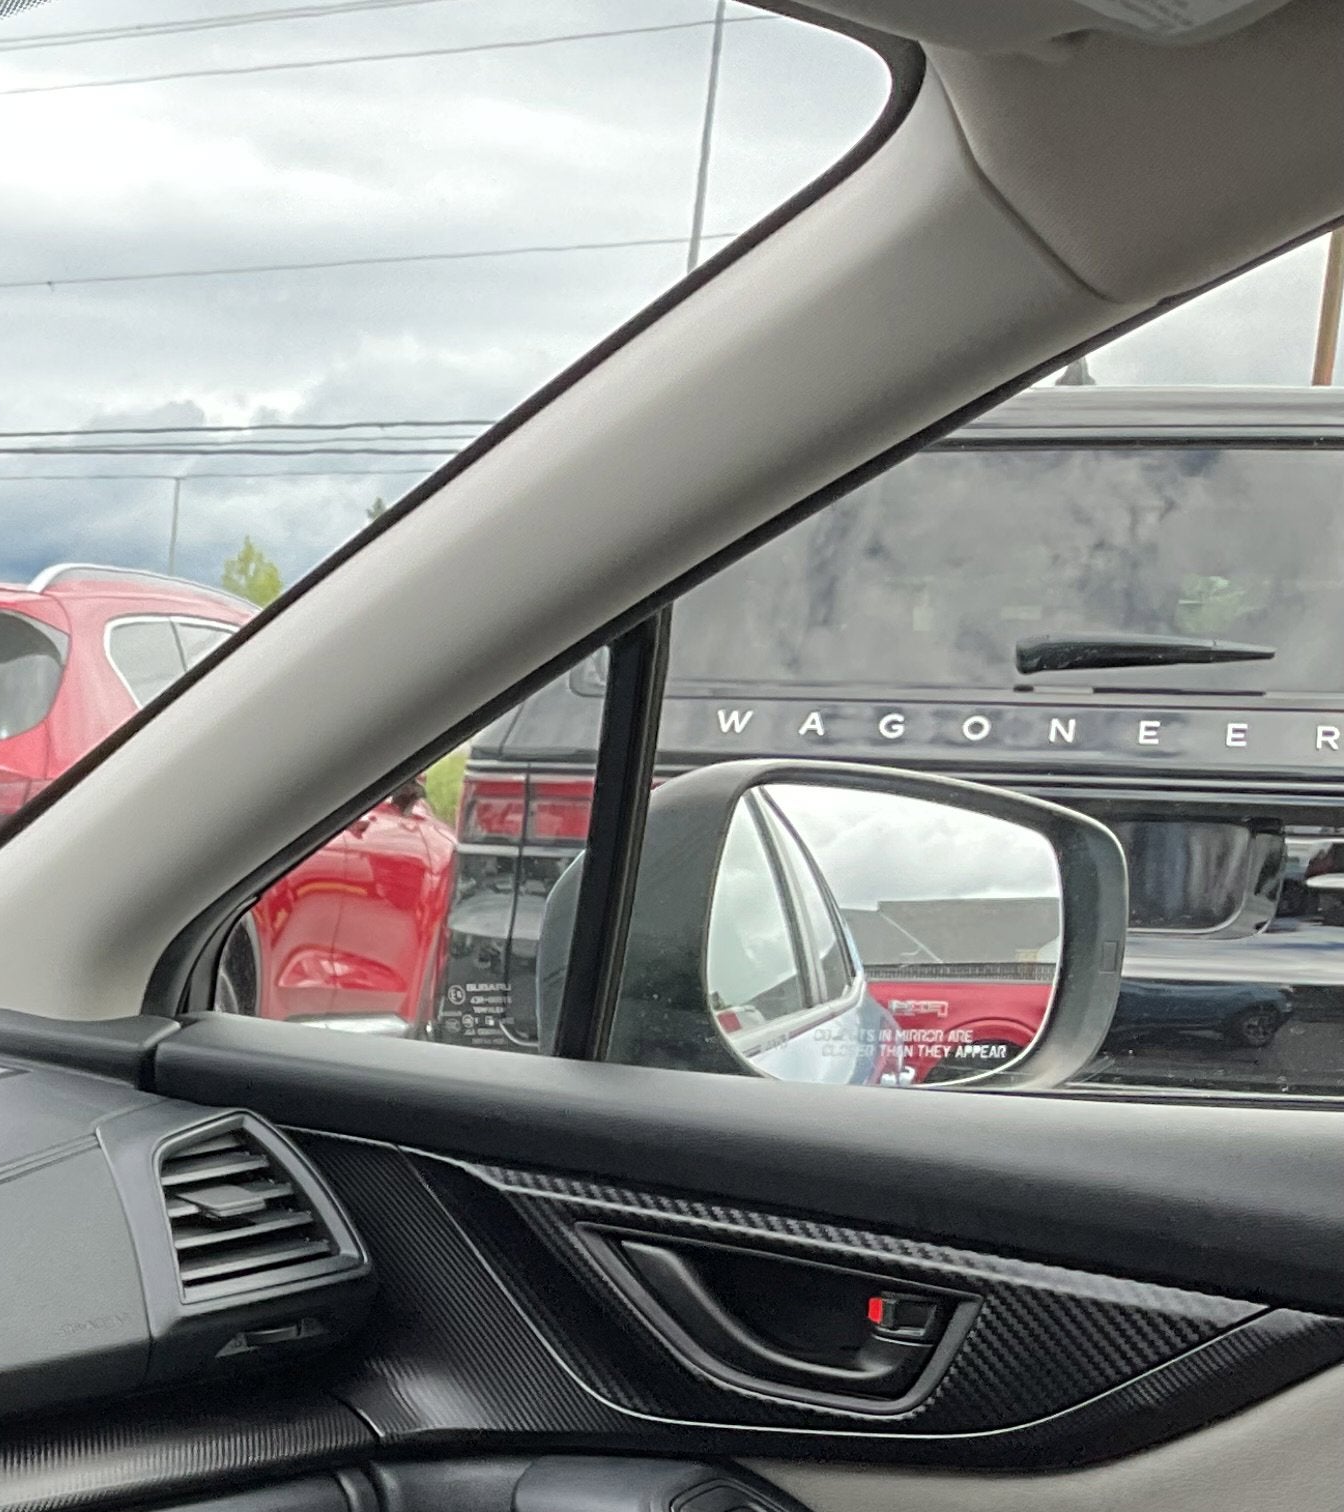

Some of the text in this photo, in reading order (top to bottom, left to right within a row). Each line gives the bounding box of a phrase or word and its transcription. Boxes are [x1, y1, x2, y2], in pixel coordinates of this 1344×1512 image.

[716, 709, 1341, 750] WAGONEER
[878, 1029, 892, 1041] IN
[895, 1029, 944, 1043] MIRROR
[947, 1029, 974, 1043] ARE
[918, 1044, 951, 1058] THEY
[954, 1045, 1008, 1059] APPEAR
